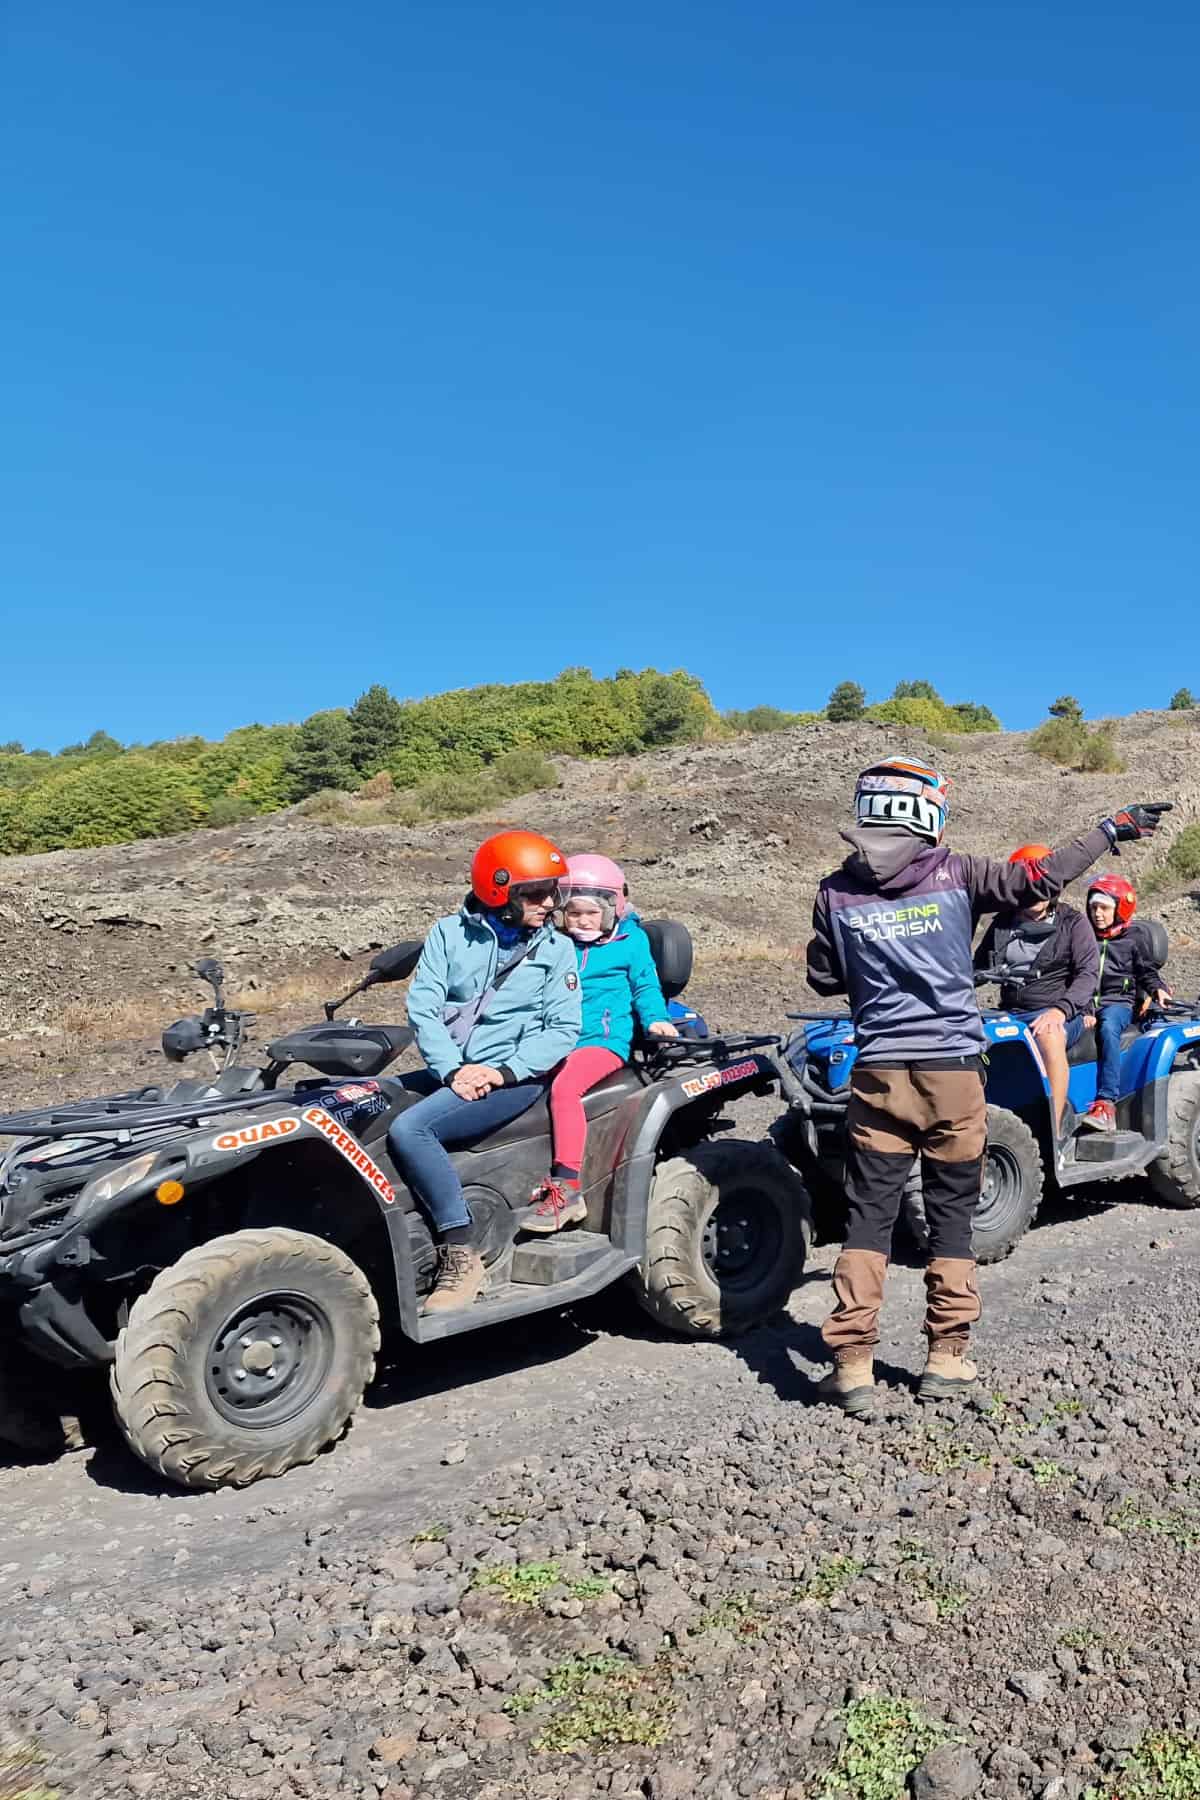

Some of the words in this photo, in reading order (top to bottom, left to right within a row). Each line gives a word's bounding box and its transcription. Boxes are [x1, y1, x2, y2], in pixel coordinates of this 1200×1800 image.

[851, 918, 943, 944] TOURISM
[215, 1118, 298, 1150] QUAD
[304, 1109, 395, 1202] EXPERIENCES
